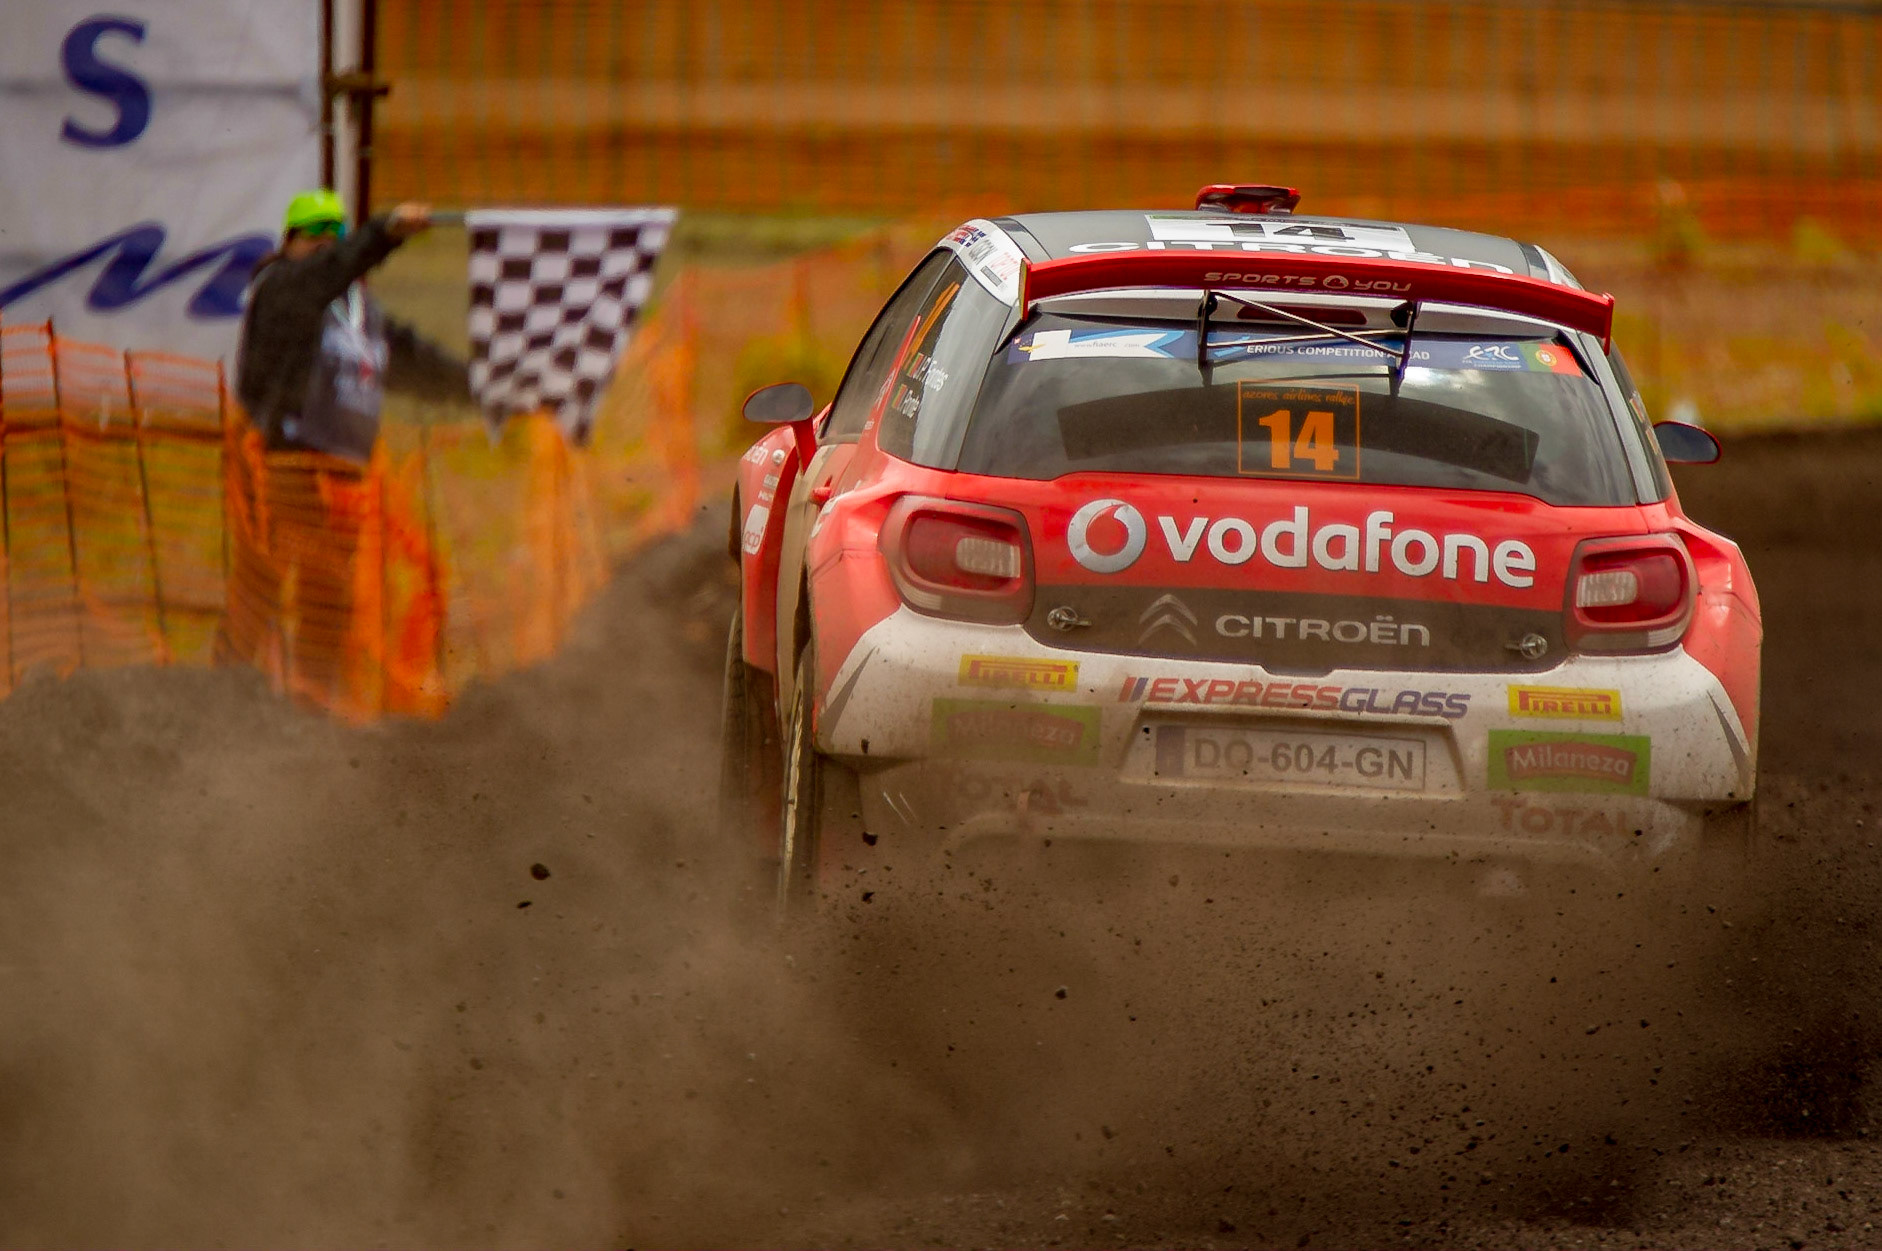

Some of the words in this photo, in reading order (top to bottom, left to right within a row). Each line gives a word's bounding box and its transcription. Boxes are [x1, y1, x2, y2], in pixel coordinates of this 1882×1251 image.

[1206, 222, 1355, 241] 14
[1203, 271, 1318, 286] SPORTS
[1297, 347, 1383, 358] COMPETITION
[1258, 409, 1339, 471] 14
[1157, 506, 1537, 588] vodafone
[968, 660, 1068, 685] PIRELLI
[1148, 677, 1471, 719] EXPRESSGLASS
[1518, 690, 1611, 715] PIRELLI
[1511, 746, 1630, 777] Milaneza
[1490, 798, 1633, 838] TOTAL
